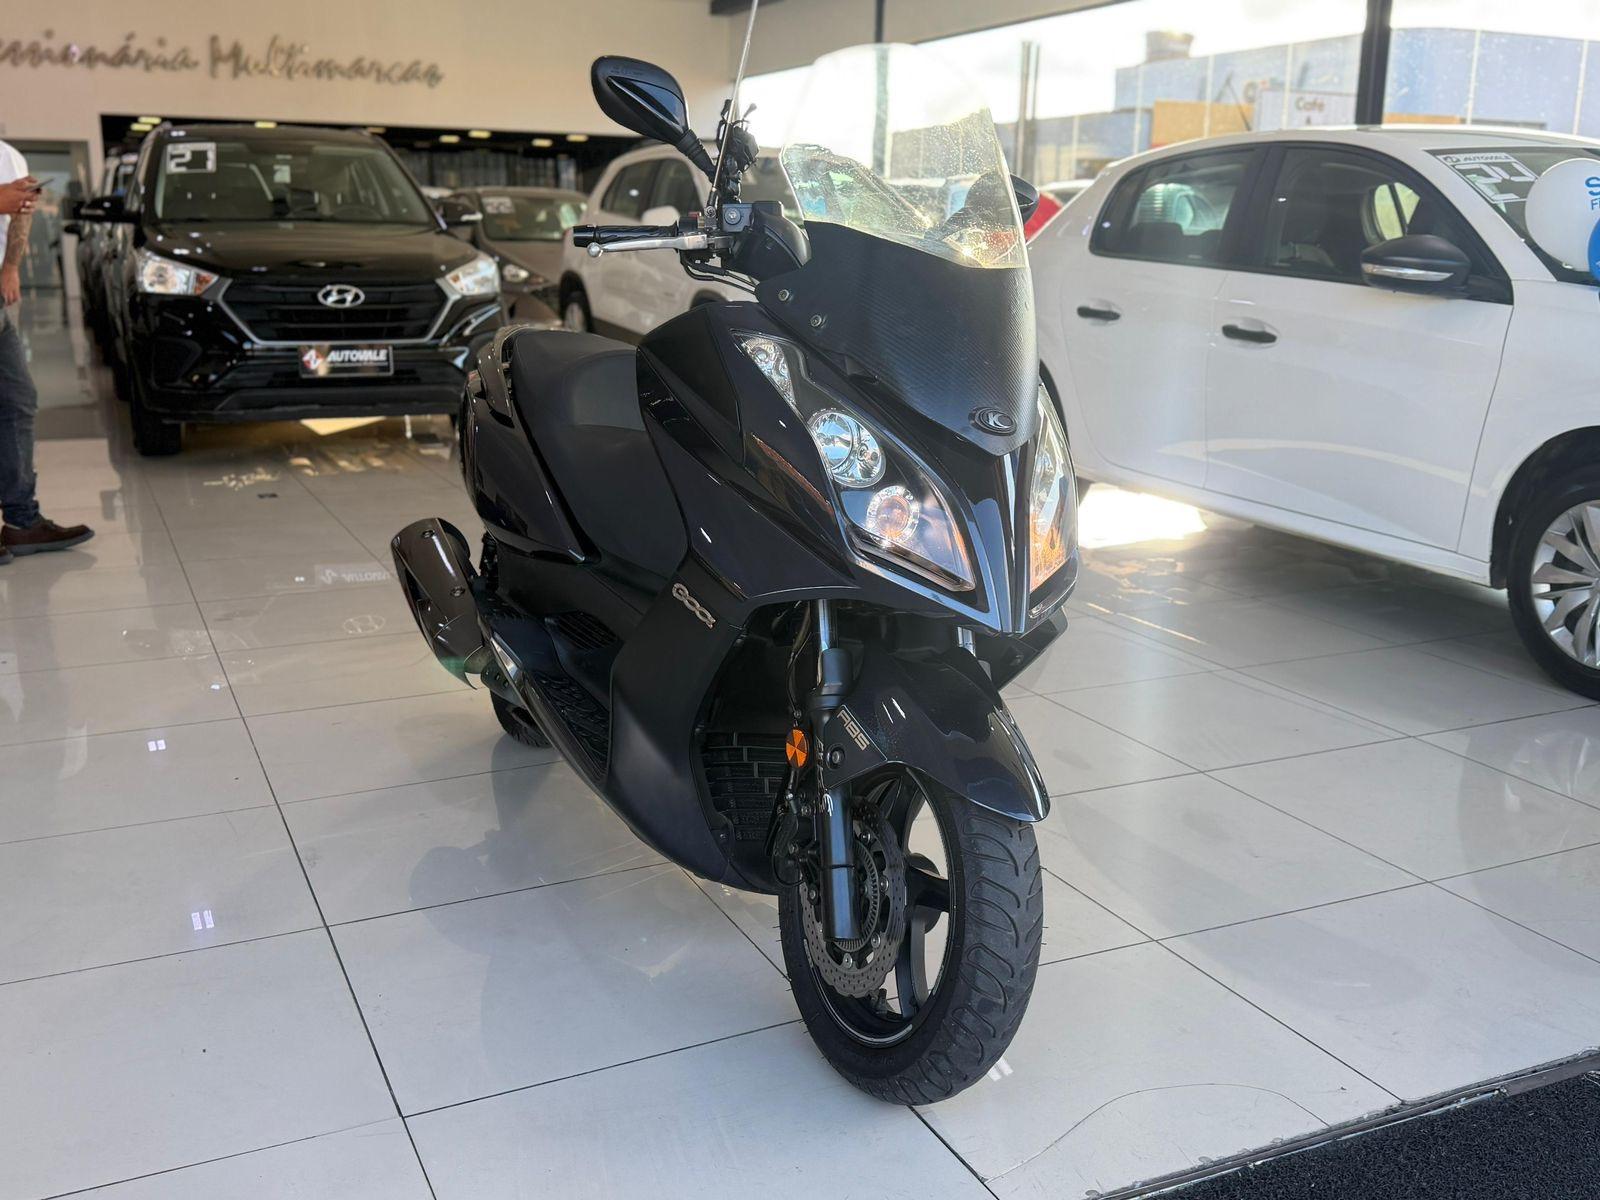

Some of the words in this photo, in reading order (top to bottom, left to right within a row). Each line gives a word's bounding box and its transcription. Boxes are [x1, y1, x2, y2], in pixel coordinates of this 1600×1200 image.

[0, 28, 199, 73] ssionária
[209, 34, 443, 88] Multimarcas
[327, 349, 388, 363] AUTOVALE
[836, 709, 870, 751] ABS
